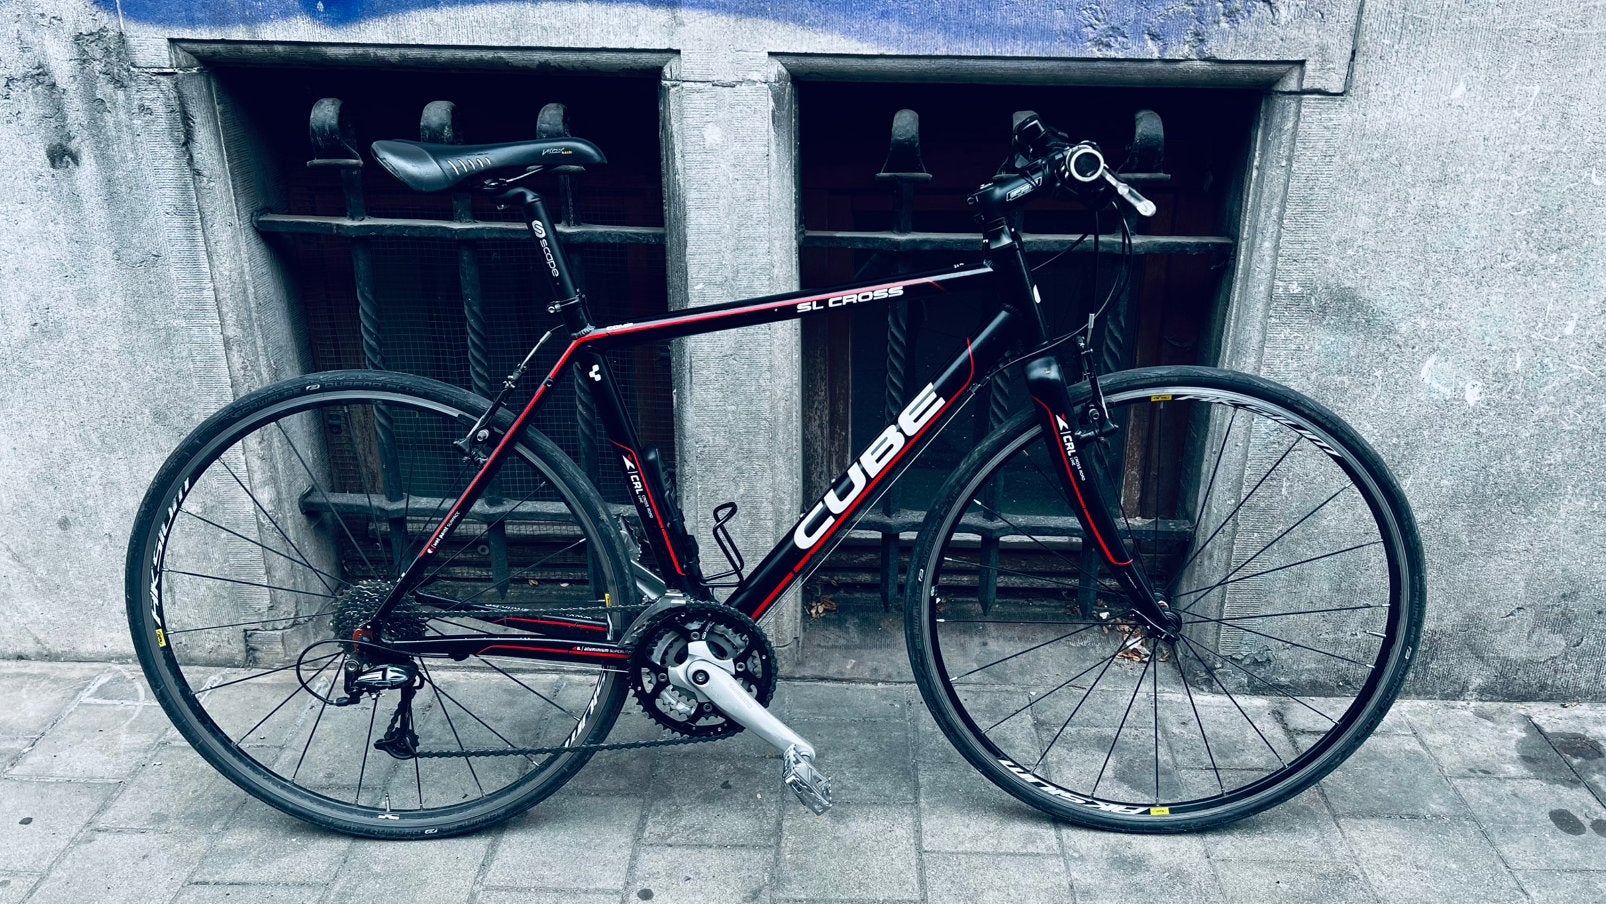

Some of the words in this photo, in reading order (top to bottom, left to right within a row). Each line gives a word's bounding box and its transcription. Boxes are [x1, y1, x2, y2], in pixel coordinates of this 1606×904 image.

[540, 239, 559, 277] scape
[796, 301, 824, 313] SL
[828, 286, 904, 307] CROSS
[1063, 435, 1076, 456] CRL
[794, 382, 946, 549] CUBE
[630, 475, 644, 495] CRL
